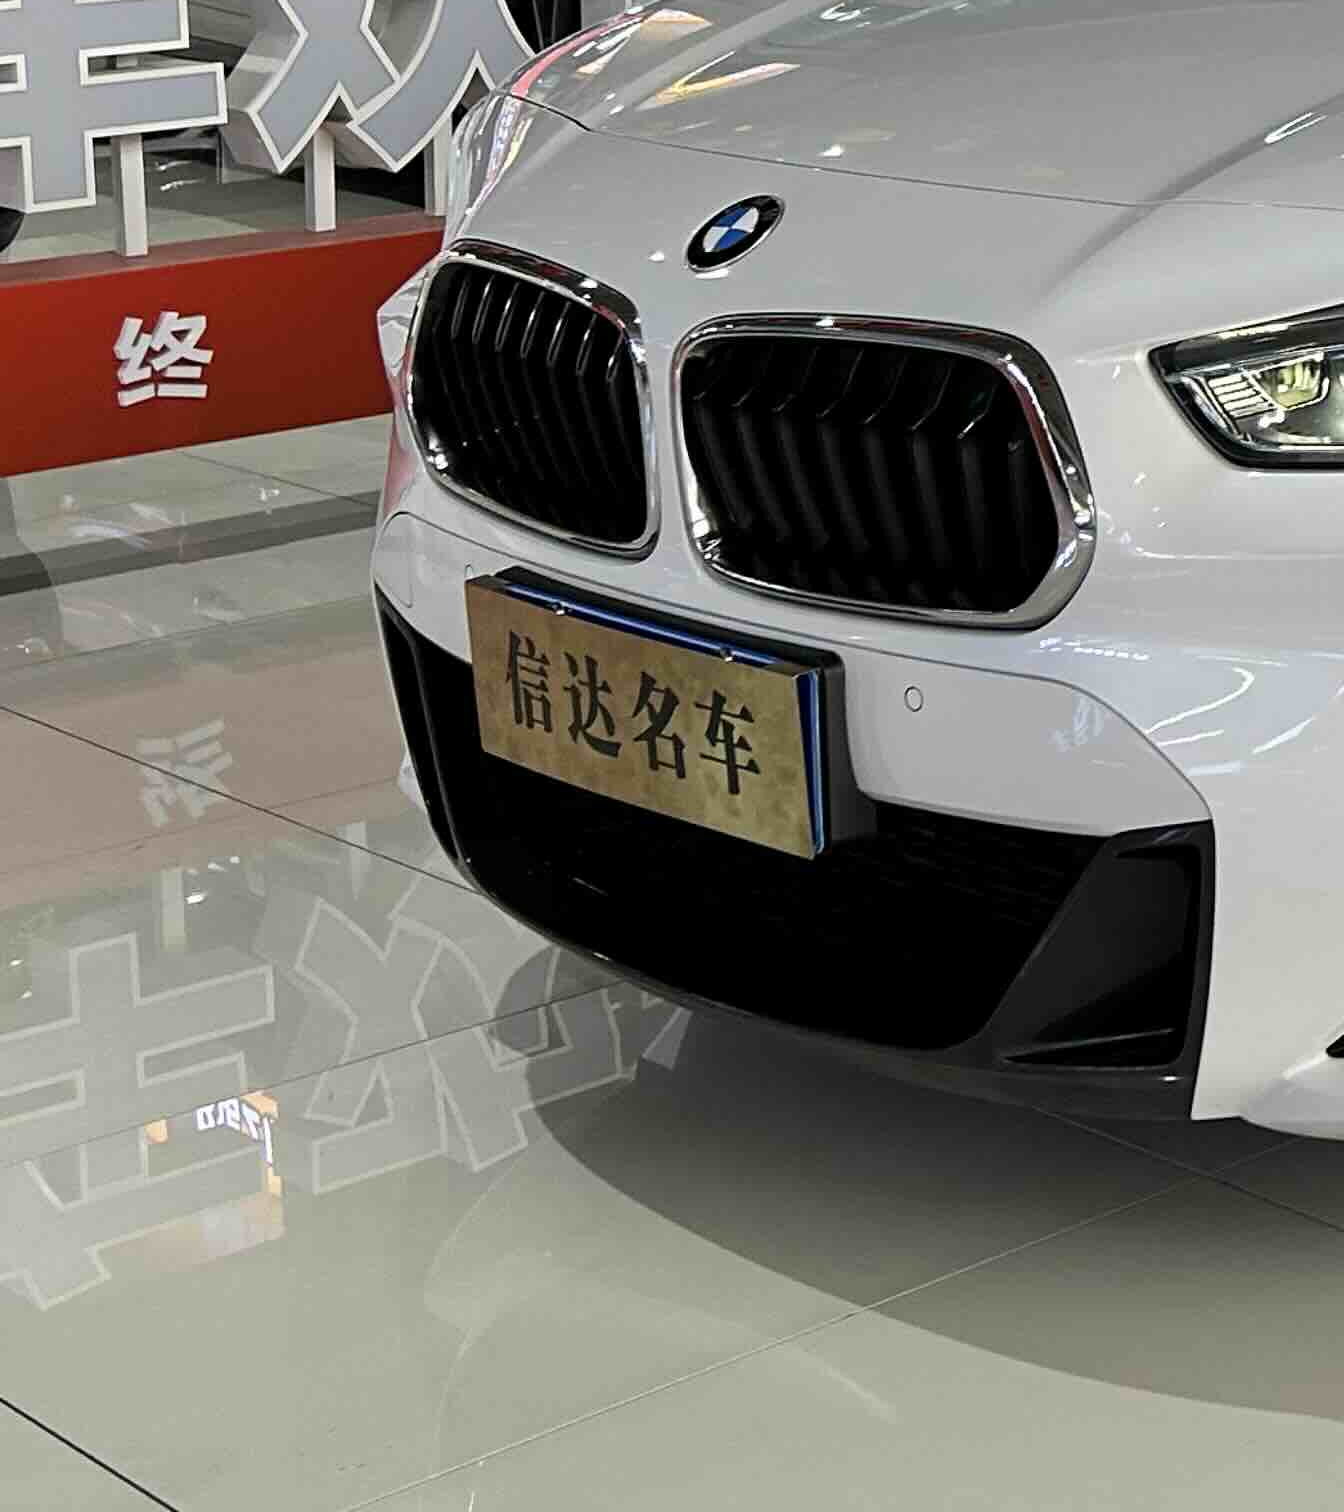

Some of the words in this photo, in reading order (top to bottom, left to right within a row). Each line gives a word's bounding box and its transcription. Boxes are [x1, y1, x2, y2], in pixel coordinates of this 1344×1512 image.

[113, 311, 215, 408] 终
[505, 629, 761, 796] 信达名车
